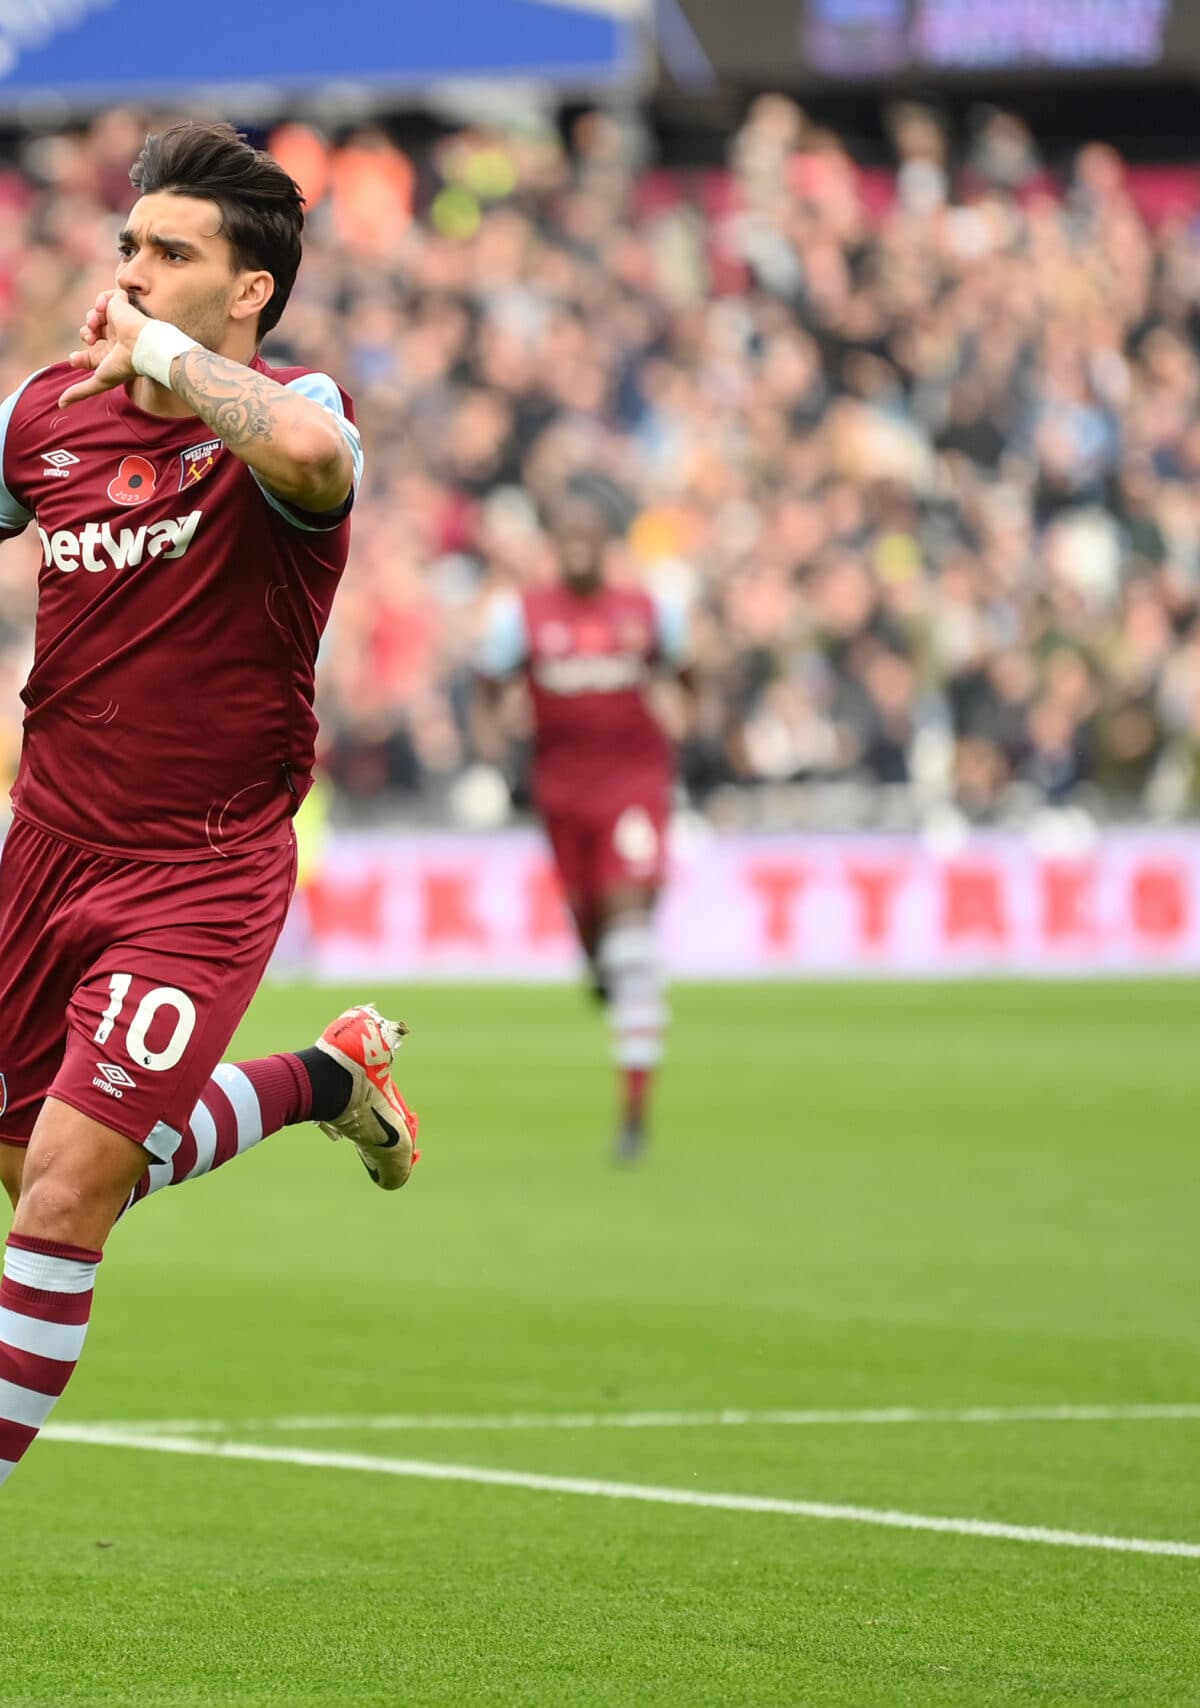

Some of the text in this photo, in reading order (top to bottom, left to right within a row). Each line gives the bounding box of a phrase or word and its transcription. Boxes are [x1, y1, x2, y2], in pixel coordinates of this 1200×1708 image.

[202, 442, 219, 453] HAM
[43, 467, 70, 478] umbro
[93, 973, 197, 1072] 10
[92, 1076, 123, 1098] umbro
